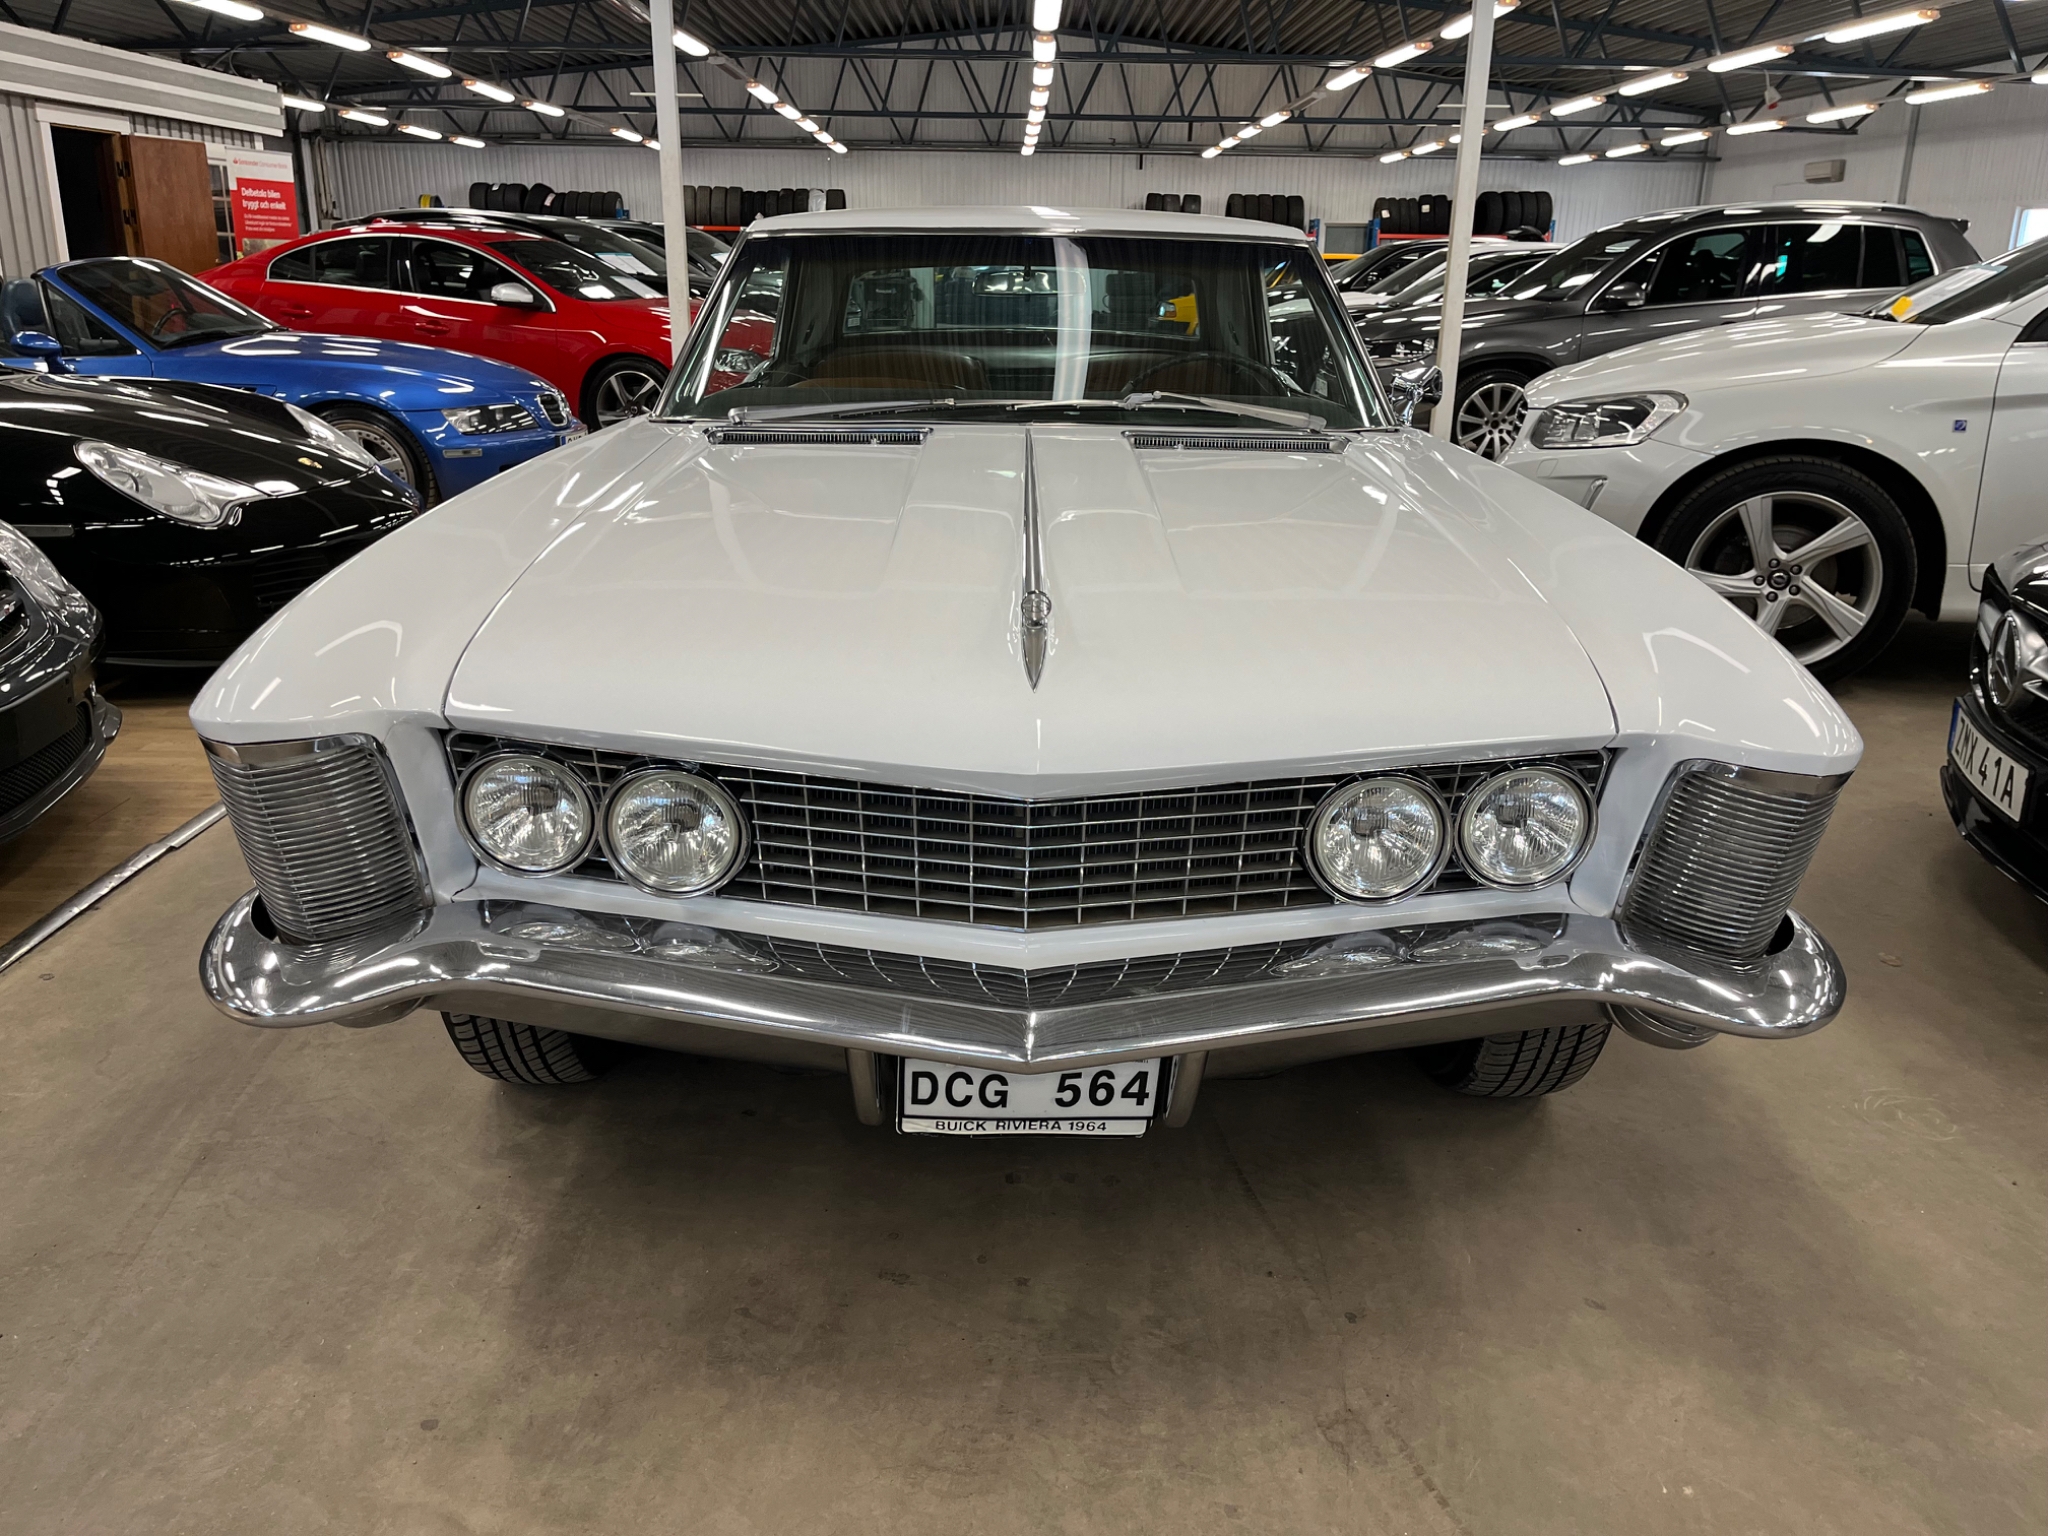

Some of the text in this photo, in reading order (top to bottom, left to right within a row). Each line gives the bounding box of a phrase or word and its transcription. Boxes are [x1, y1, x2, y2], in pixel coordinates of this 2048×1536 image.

[241, 187, 281, 199] Delbetala bilen
[242, 199, 287, 211] tryggt och enkelt
[1955, 716, 2015, 810] ZMX 41A
[910, 1069, 1150, 1108] DCG 564
[935, 1120, 1107, 1132] BUICK RIVIERA 1964
